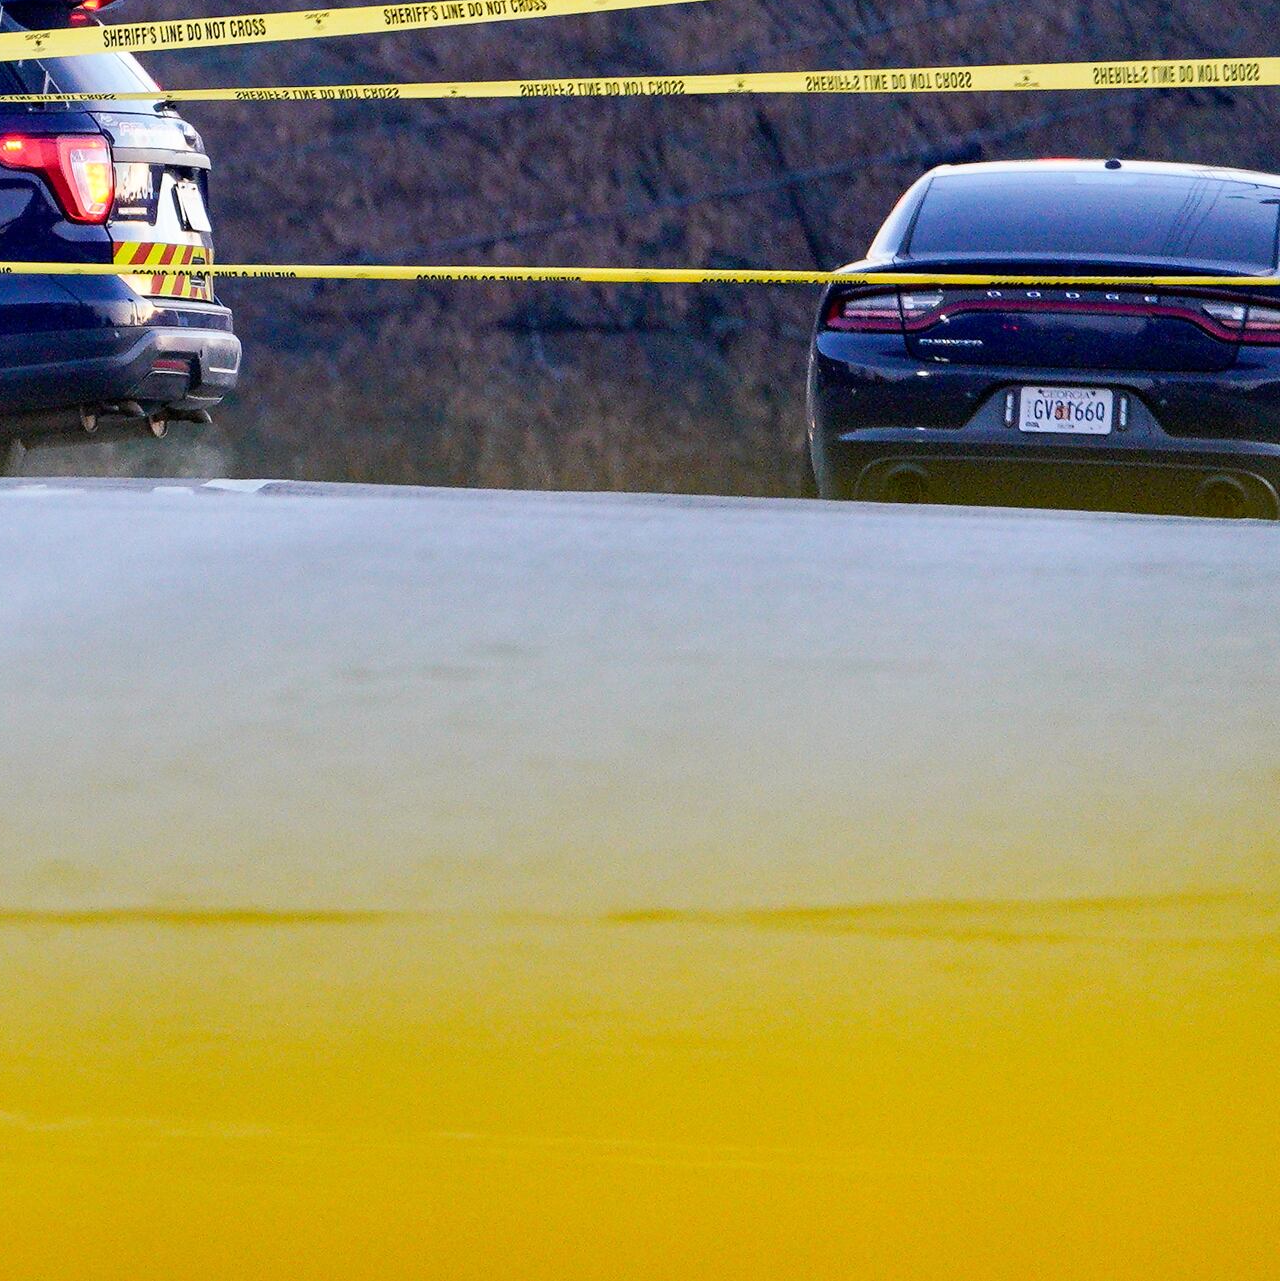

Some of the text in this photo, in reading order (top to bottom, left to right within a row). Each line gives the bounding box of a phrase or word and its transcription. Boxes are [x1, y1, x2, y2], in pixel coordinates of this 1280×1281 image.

[383, 4, 438, 25] SHERIFF'S
[440, 2, 465, 21] LINE
[468, 1, 483, 19] DO
[486, 0, 508, 18] NOT
[103, 17, 267, 49] SHERIFF'S LINE DO NOT CROSS
